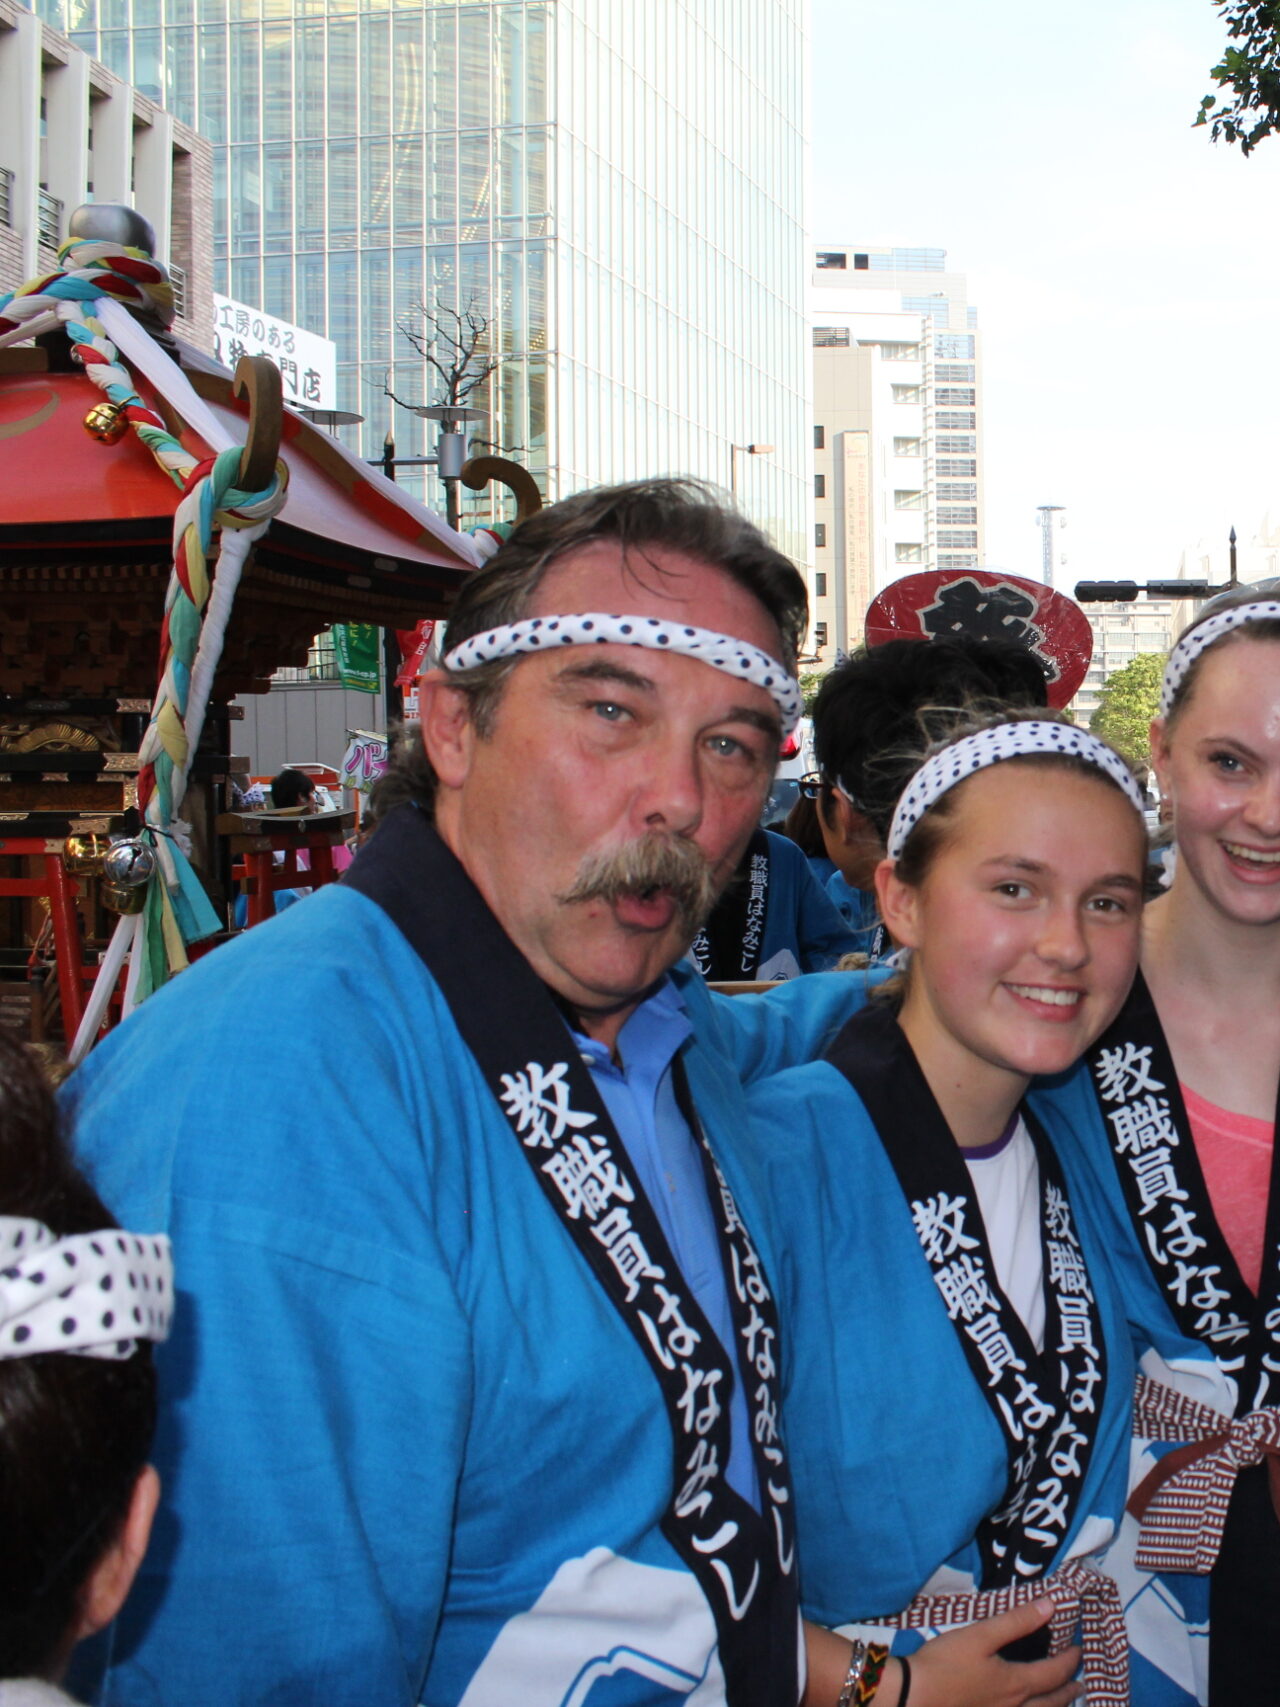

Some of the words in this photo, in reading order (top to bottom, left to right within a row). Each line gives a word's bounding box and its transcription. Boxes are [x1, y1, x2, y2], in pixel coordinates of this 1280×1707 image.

[692, 927, 712, 976] みこし
[741, 854, 769, 972] 教職員はなみこし
[500, 1060, 761, 1622] 教職員はなみこし
